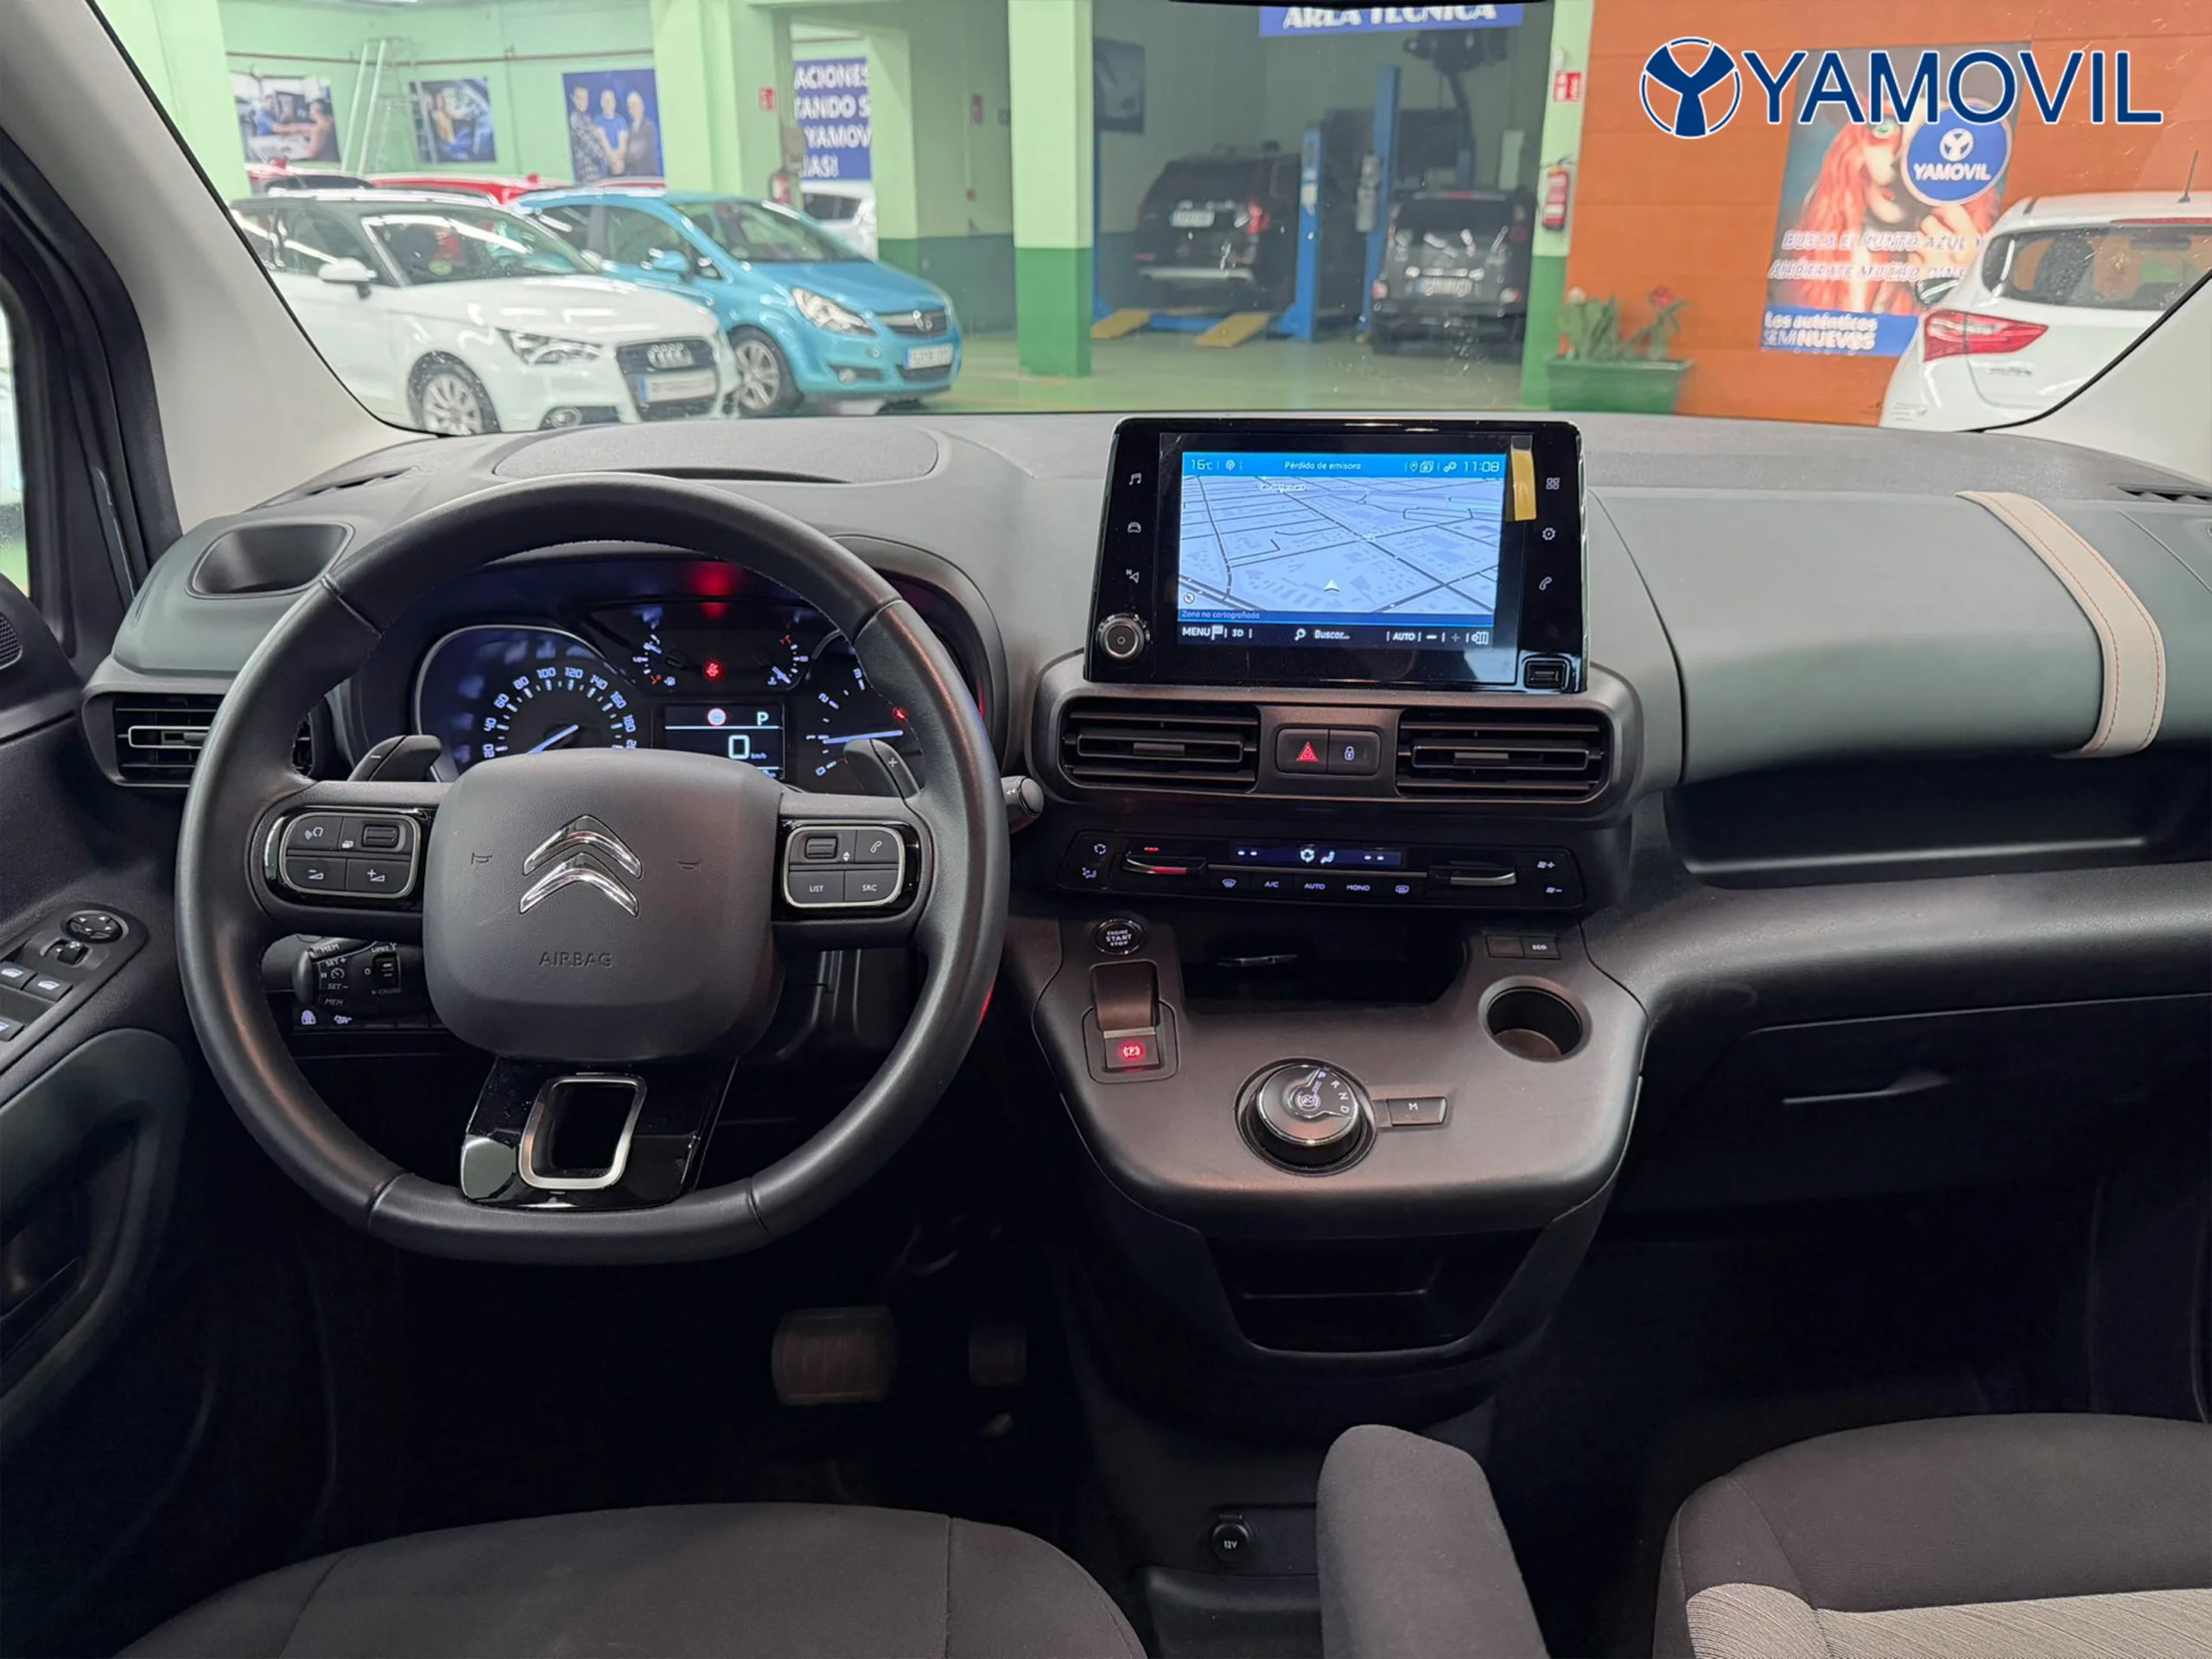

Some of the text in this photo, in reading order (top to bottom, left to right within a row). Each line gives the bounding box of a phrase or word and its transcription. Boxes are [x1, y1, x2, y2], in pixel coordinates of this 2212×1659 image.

[1913, 162, 1992, 181] YAMOVIL
[1764, 311, 1791, 328] Los
[1763, 328, 1876, 350] SEMINUEVOS
[1284, 461, 1314, 470] Pérdida
[1316, 461, 1327, 470] de
[1464, 461, 1500, 472] 11:08
[1182, 626, 1210, 637] MENU
[1232, 628, 1244, 638] 3D
[1392, 632, 1416, 642] AUTO
[536, 667, 557, 679] 100
[564, 667, 584, 679] 120
[853, 668, 862, 679] 3
[512, 676, 530, 690] 80
[589, 674, 608, 690] 140
[493, 693, 510, 709] 60
[610, 691, 627, 709] 160
[817, 693, 830, 703] 2
[483, 717, 497, 732] 40
[622, 714, 637, 733] 180
[756, 711, 769, 726] P
[482, 743, 495, 759] 20
[728, 734, 750, 760] 0
[1106, 933, 1132, 942] START
[539, 951, 612, 969] AIRBAG
[1331, 1080, 1340, 1089] R
